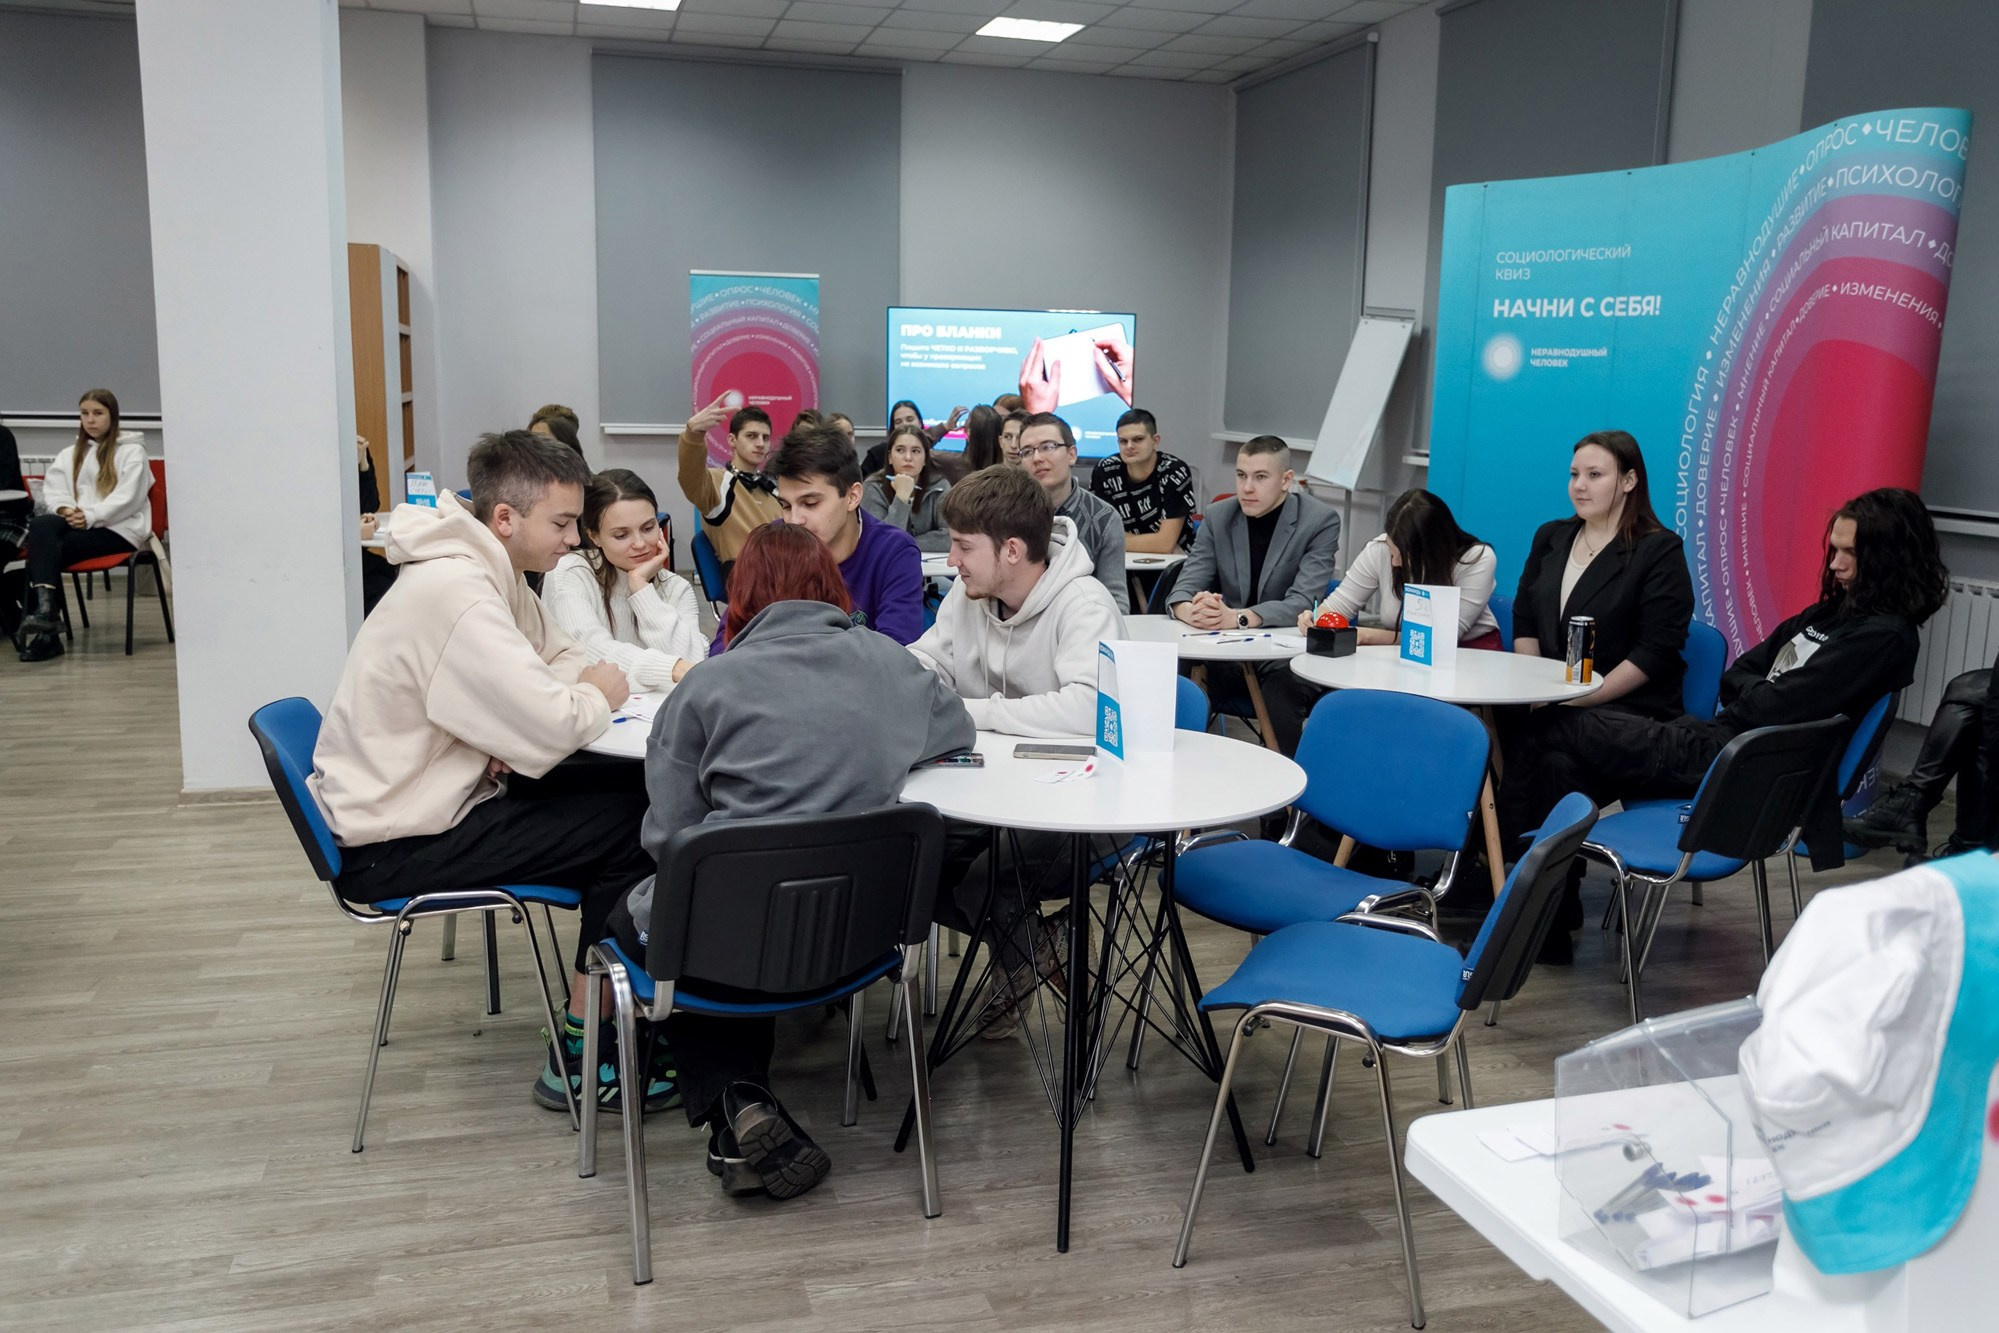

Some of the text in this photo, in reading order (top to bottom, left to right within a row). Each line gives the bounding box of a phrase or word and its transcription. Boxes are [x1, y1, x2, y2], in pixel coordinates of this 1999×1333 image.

[1496, 244, 1631, 264] СОЦИОЛОГИЧЕСКИЙ
[1831, 221, 1926, 247] КАПИТАЛ
[1495, 268, 1531, 280] КВИЗ
[1769, 225, 1829, 312] СОЦИАЛЬНЫЙ
[720, 285, 754, 297] ОПРОС
[760, 286, 802, 304] ЧЕЛОВЕК
[1493, 295, 1661, 318] НАЧНИ С СЕБЯ!
[1798, 284, 1830, 323] ДОВЕРИЕ
[1840, 282, 1939, 325] ИЗМЕНЕНИЯ
[900, 324, 1002, 339] ПРО БЛАНКИ
[1530, 347, 1608, 357] НЕРАВНОДУШНЫЙ
[1675, 366, 1709, 541] СОЦИОЛОГИЯ
[1710, 168, 1799, 345] НЕРАВНОДУШИЕ
[1806, 123, 1858, 171] ОПРОС
[1696, 407, 1717, 516] ДОВЕРИЕ
[1716, 259, 1771, 388] ИЗМЕНЕНИЯ
[1777, 177, 1827, 251] РАЗВИТИЕ
[1768, 320, 1797, 377] КАПИТАЛ
[1530, 359, 1568, 367] ЧЕЛОВЕК
[1738, 322, 1766, 399] МНЕНИЕ
[1743, 379, 1770, 488] СОЦИАЛЬНЫЙ
[1169, 466, 1188, 486] GAP
[1720, 415, 1739, 505] ЧЕЛОВЕК
[1719, 518, 1730, 586] ОПРОС
[1741, 502, 1749, 567] МНЕНИЕ
